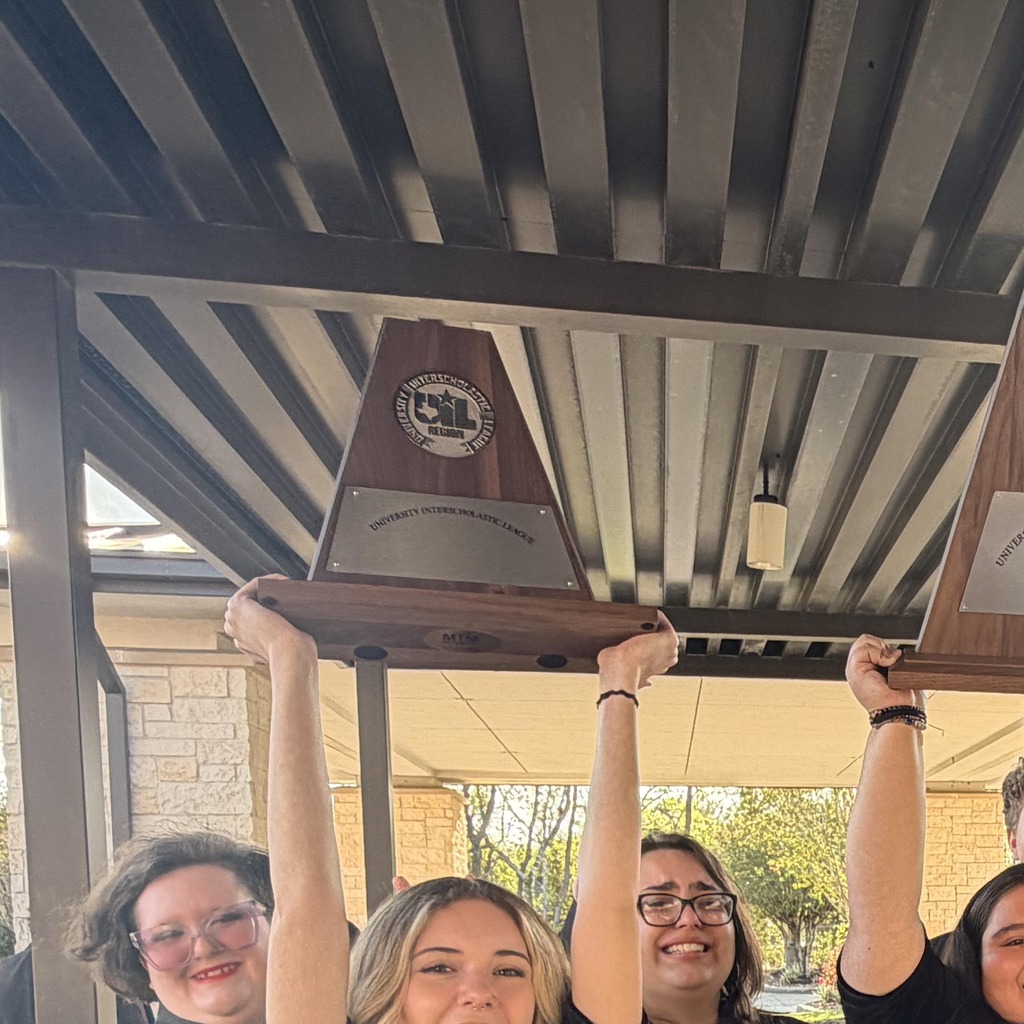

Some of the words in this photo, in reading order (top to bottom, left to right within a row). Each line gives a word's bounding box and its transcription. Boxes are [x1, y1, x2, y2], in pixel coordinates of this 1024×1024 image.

[414, 389, 477, 430] UIL
[369, 507, 420, 531] UNIVERSITY
[422, 506, 502, 526] INTERSCHOLASTIC
[501, 521, 536, 545] LEAGUE
